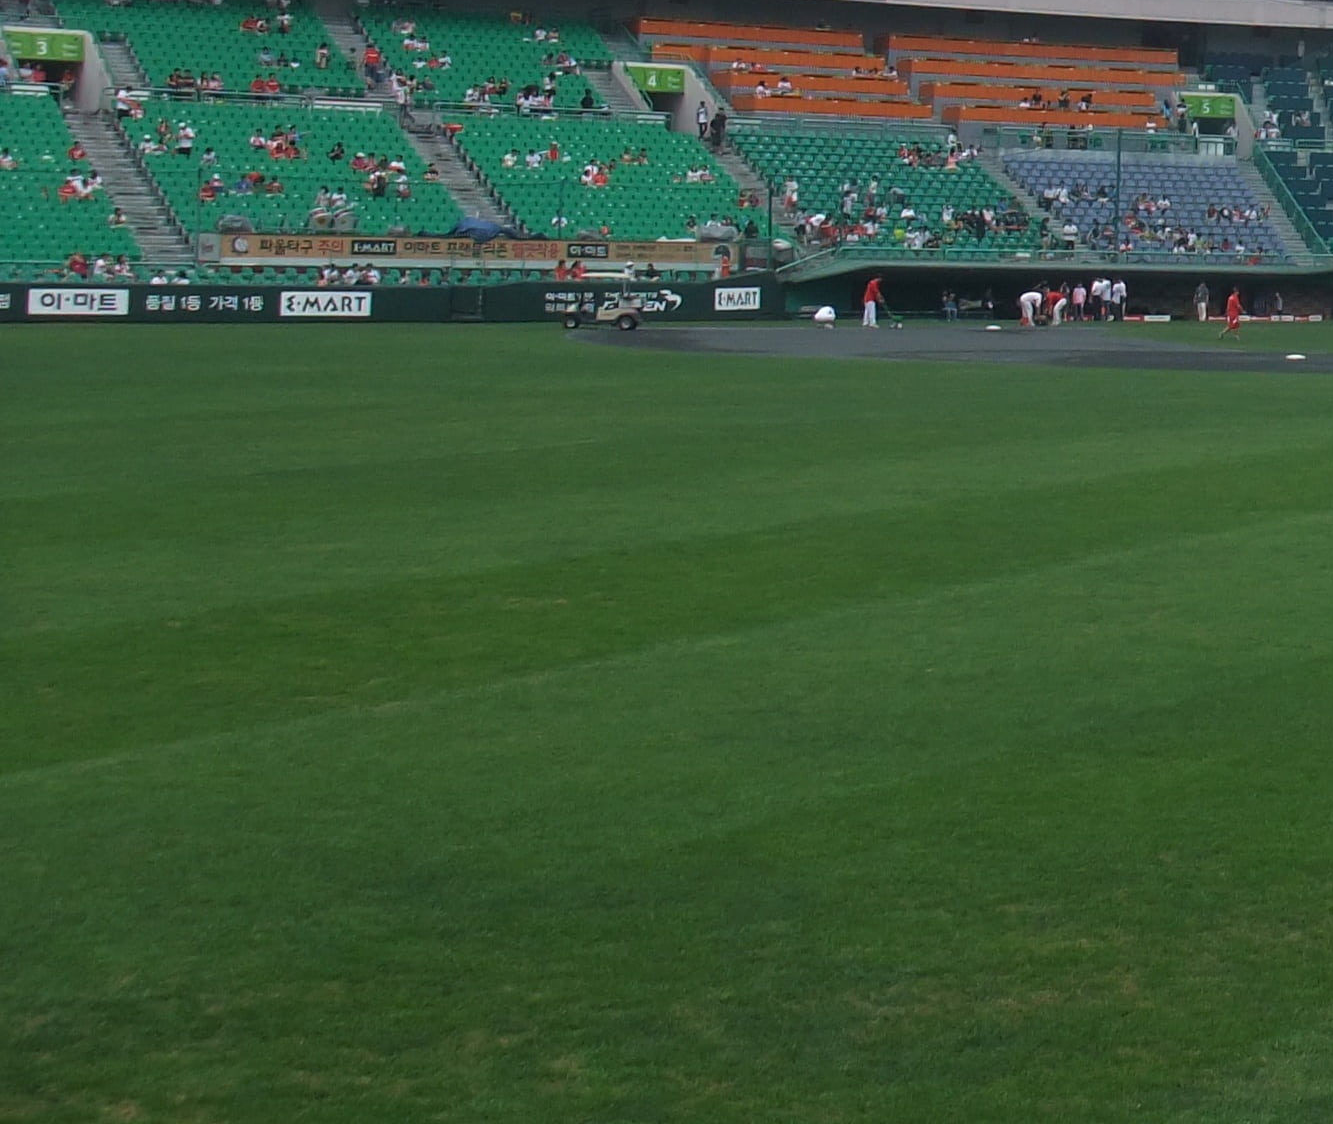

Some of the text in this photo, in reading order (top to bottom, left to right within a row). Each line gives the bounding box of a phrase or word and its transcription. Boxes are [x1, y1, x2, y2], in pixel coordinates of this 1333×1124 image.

[37, 40, 48, 56] 3
[647, 74, 657, 88] 4
[1203, 102, 1211, 114] 5
[208, 295, 239, 311] 가격
